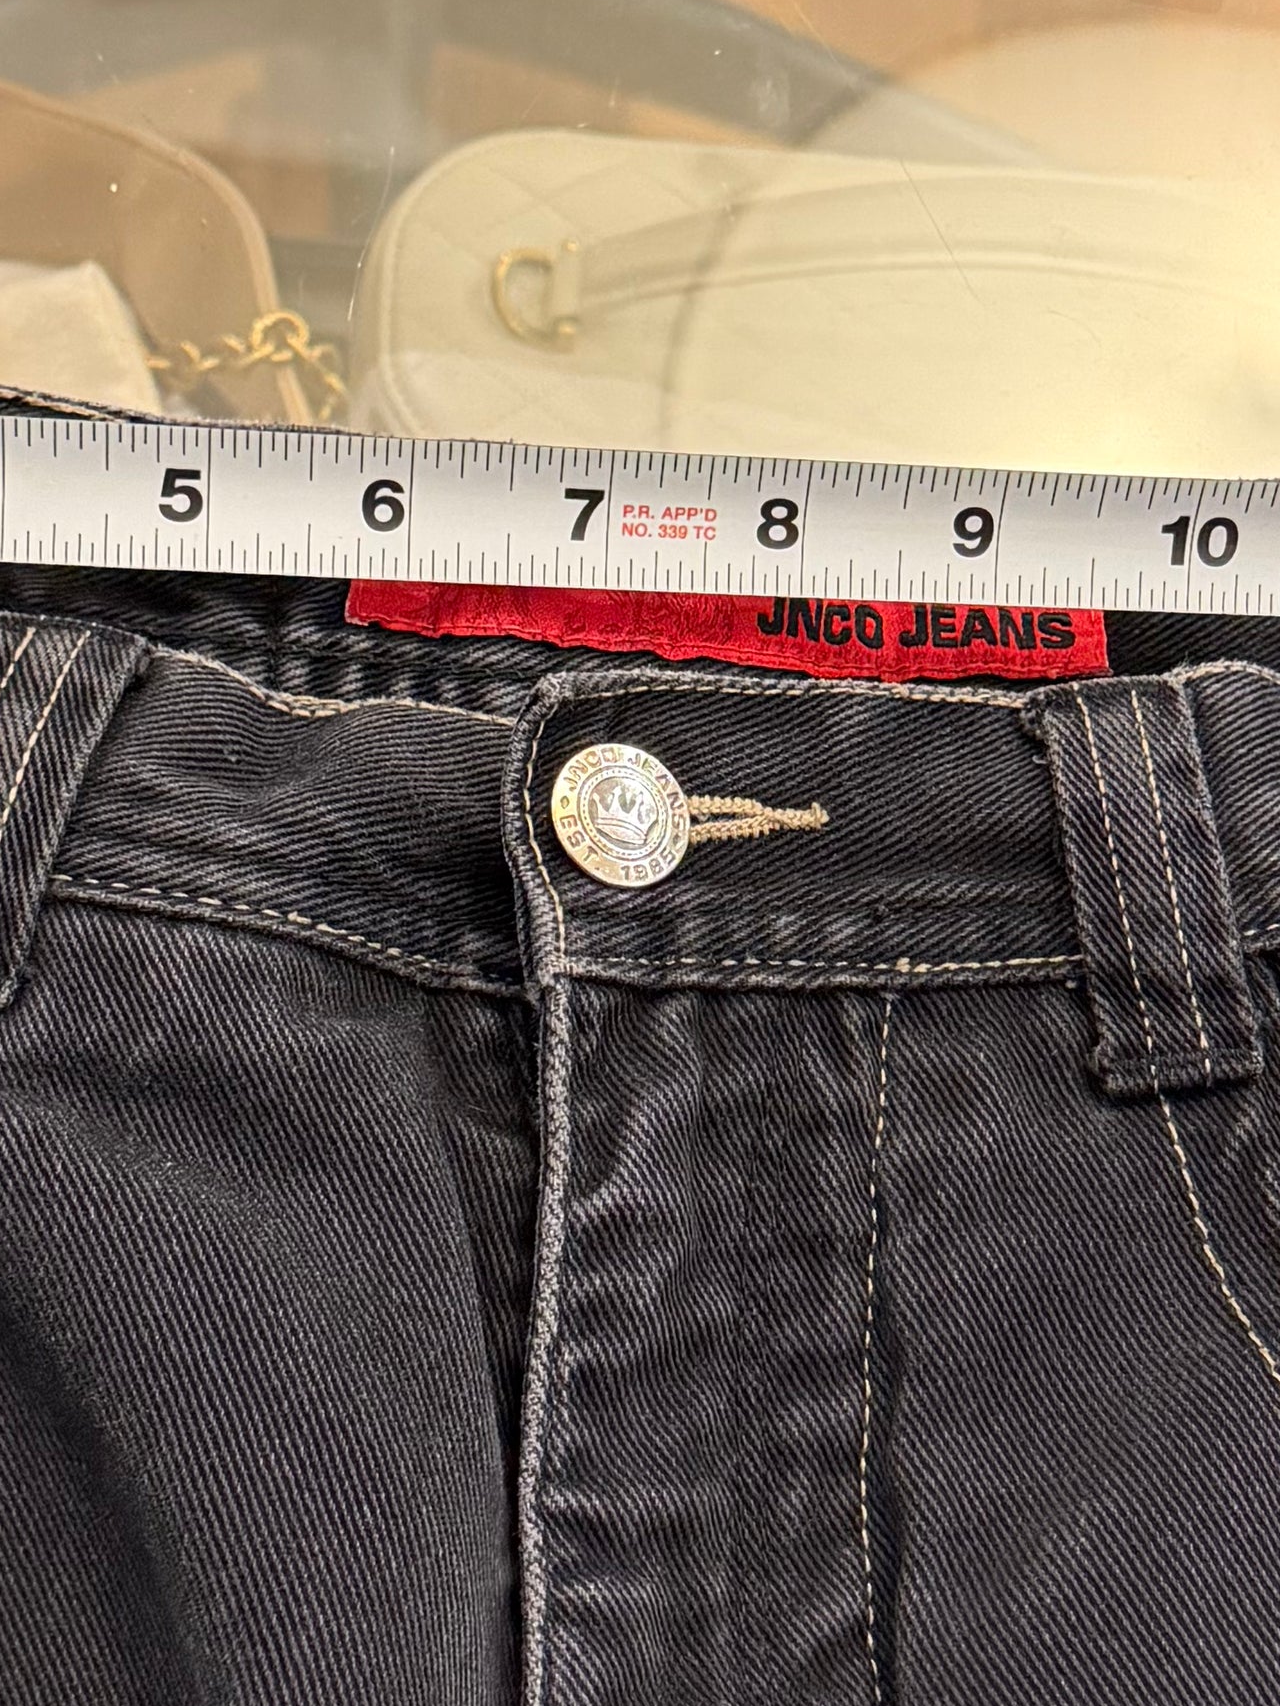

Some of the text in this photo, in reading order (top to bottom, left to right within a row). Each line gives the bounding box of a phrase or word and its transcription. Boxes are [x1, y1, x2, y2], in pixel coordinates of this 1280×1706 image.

[159, 468, 203, 524] 5
[362, 480, 405, 532] 6
[564, 488, 606, 541] 7
[623, 504, 718, 522] P.R. APP'D
[622, 522, 717, 541] NO. 339 TC
[757, 497, 800, 550] 8
[952, 506, 996, 559] 9
[1160, 515, 1238, 567] 10
[757, 596, 1076, 650] JNCO JEANS
[563, 746, 689, 831] JNCO JEANS
